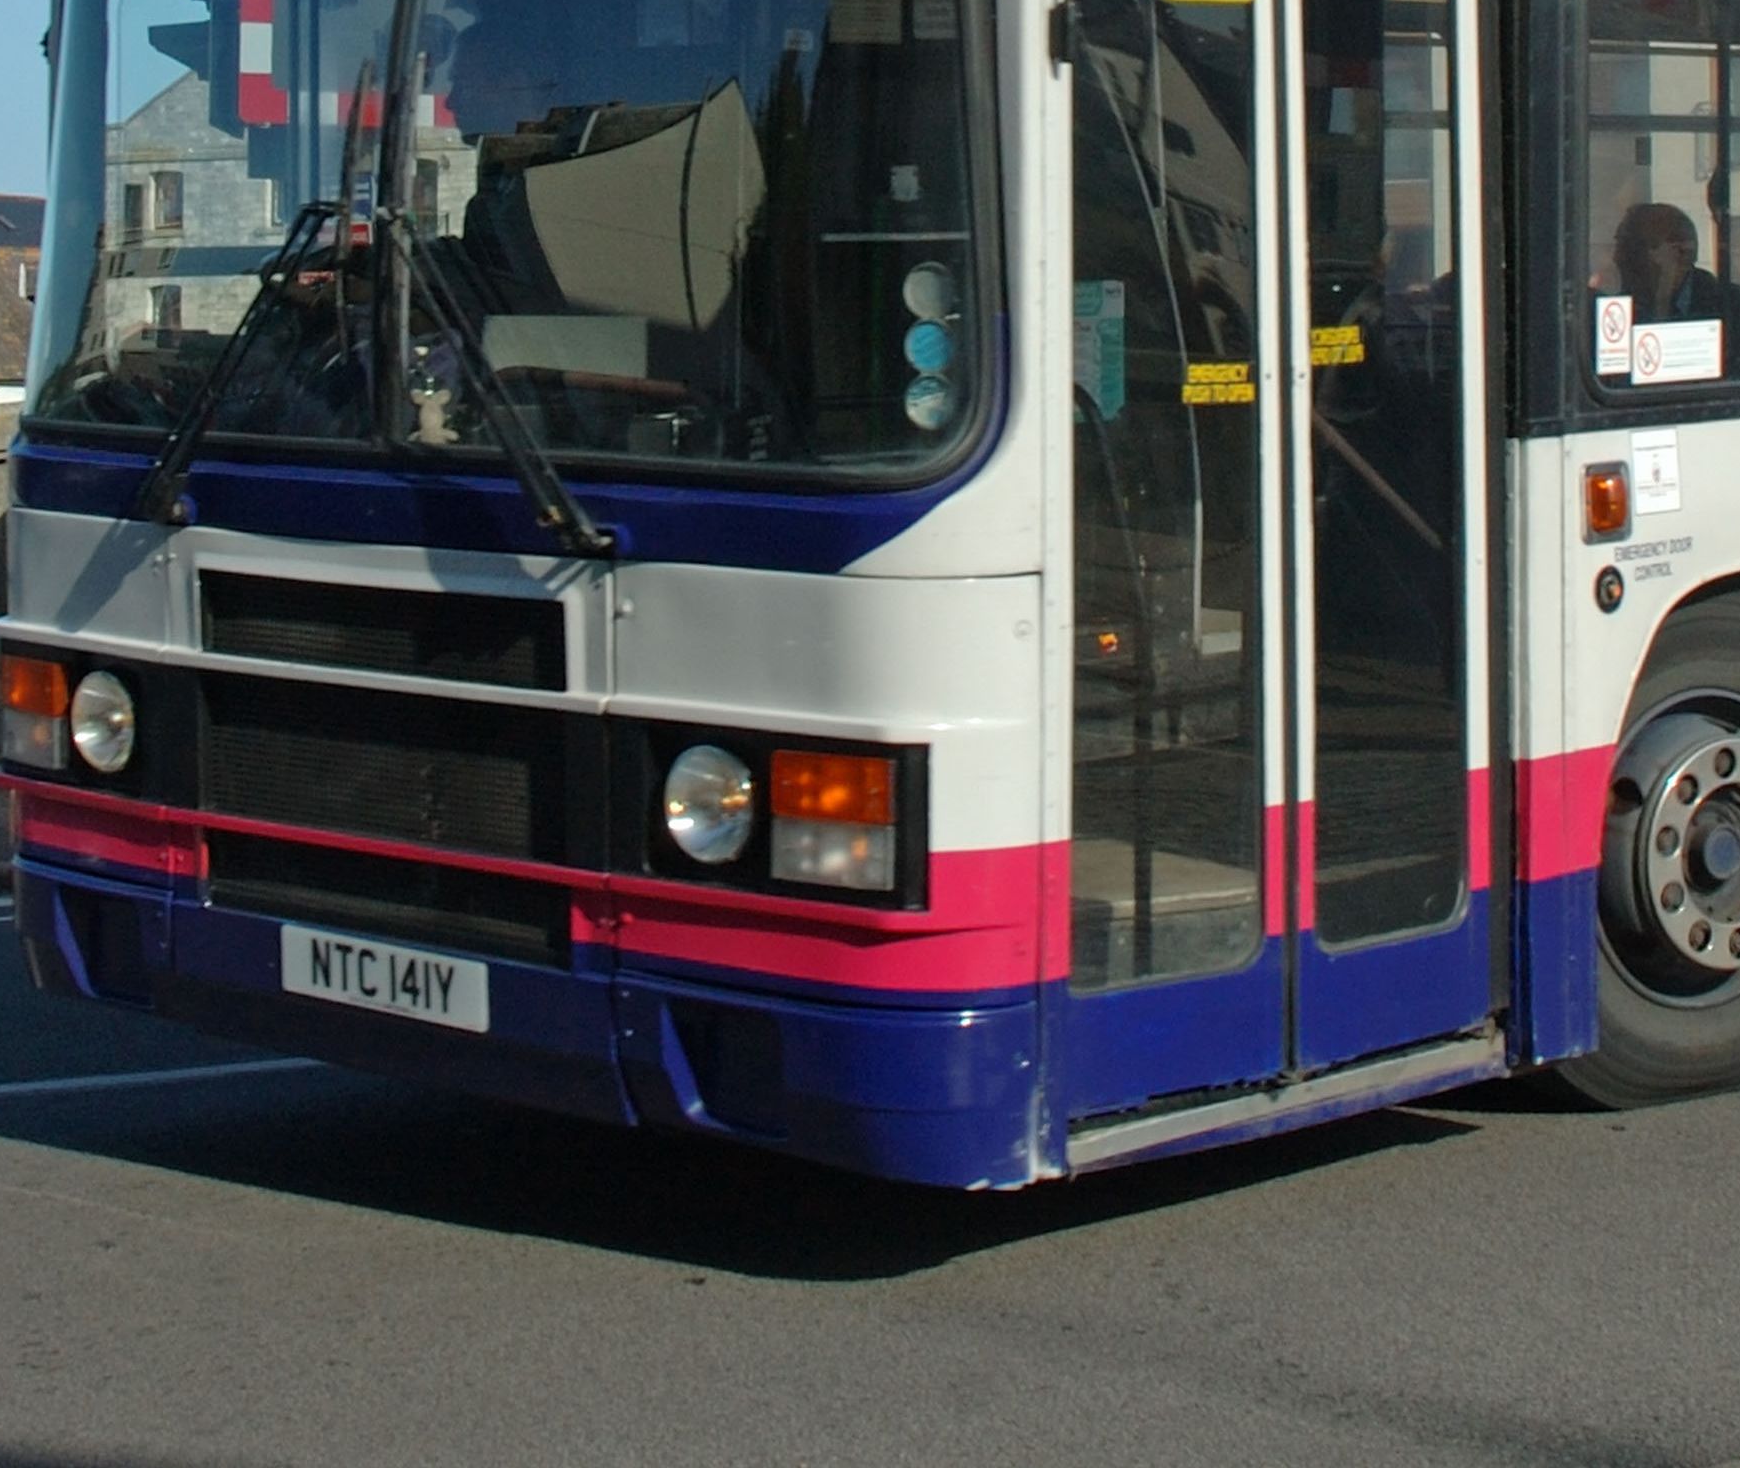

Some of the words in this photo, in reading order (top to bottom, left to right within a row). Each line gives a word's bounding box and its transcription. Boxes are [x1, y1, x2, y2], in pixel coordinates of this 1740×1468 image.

[1614, 540, 1668, 563] EMERGENCY
[1669, 535, 1693, 554] DOOR
[1634, 562, 1673, 582] CONTROL
[311, 938, 378, 998] NTC
[389, 953, 455, 1015] 141Y
